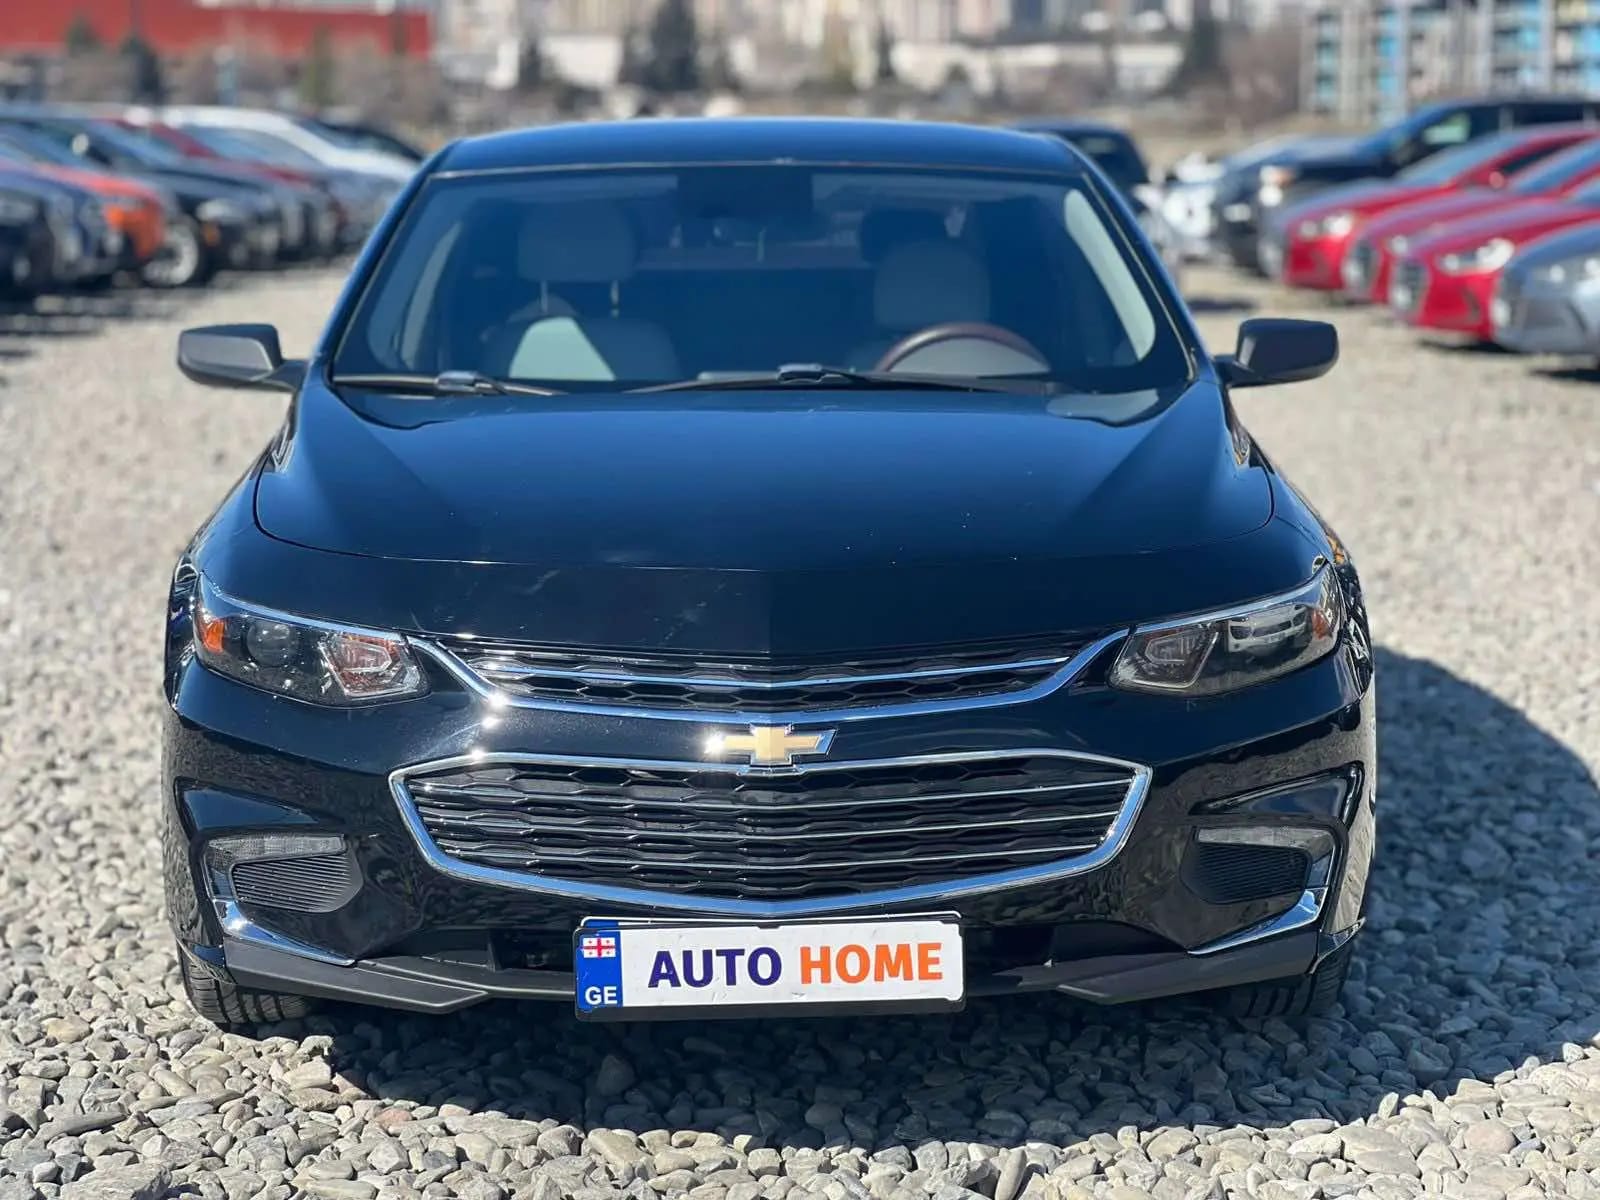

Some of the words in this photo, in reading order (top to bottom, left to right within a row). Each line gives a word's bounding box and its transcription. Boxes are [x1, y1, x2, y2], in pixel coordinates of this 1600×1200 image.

[647, 946, 782, 989] AUTO
[800, 942, 943, 985] HOME
[585, 986, 617, 1005] GE
